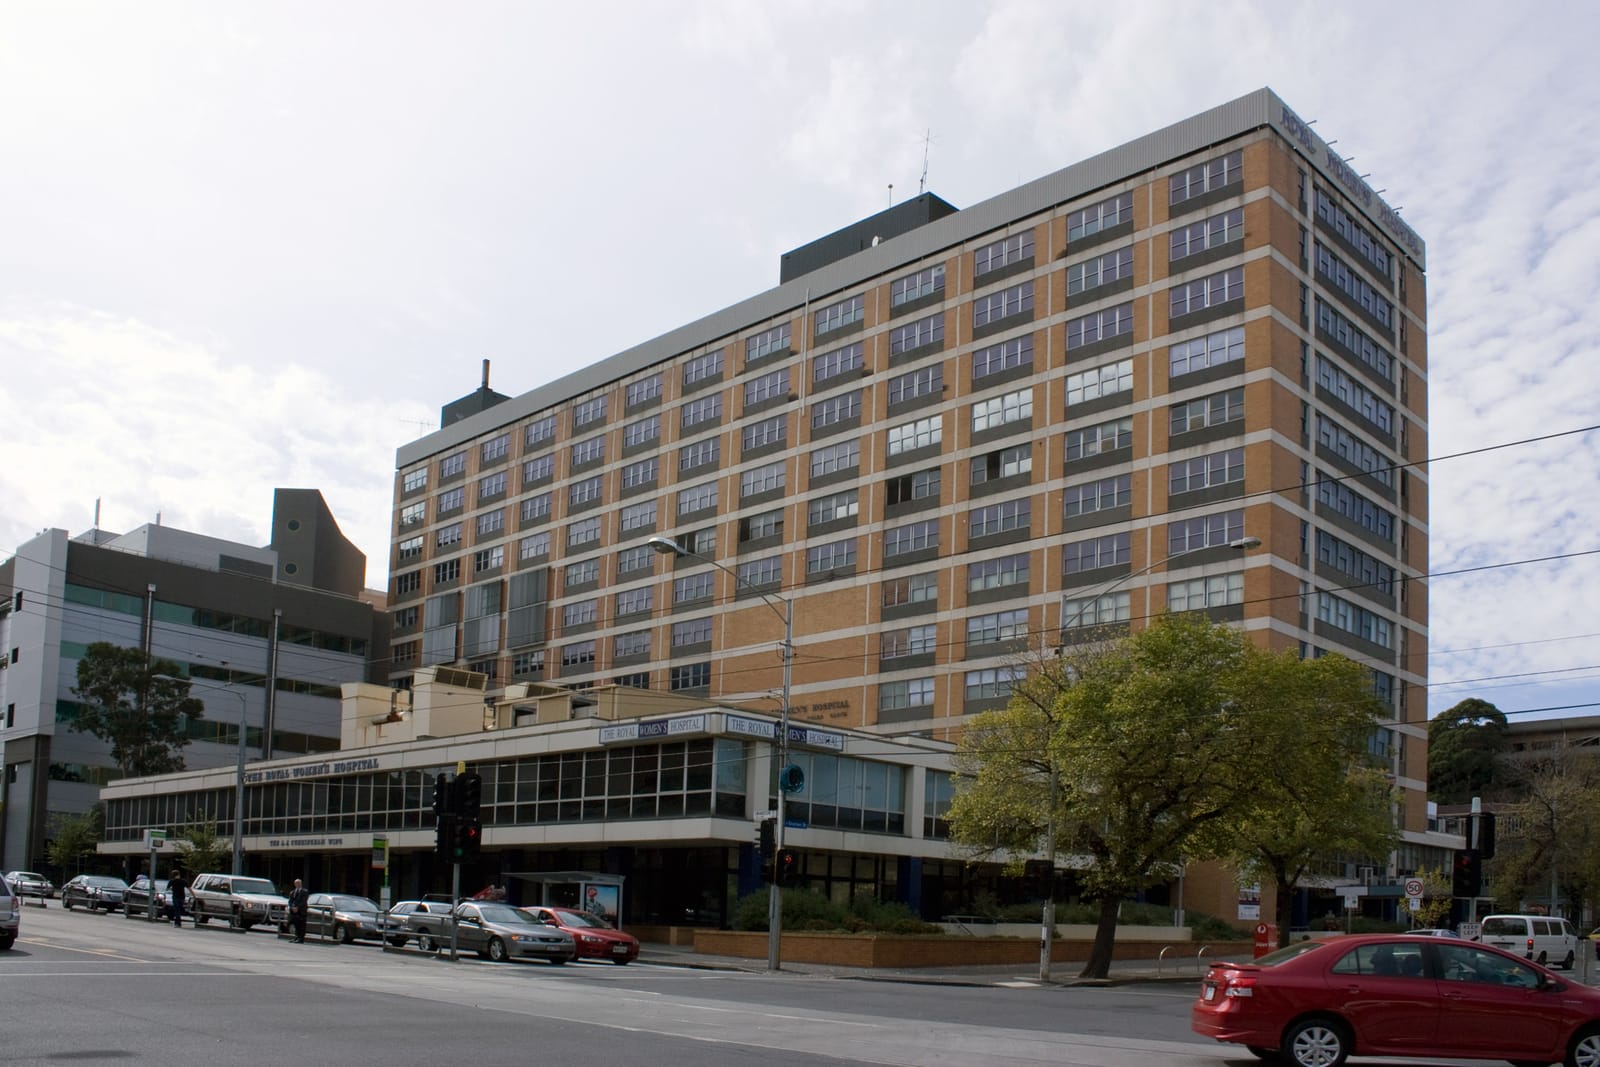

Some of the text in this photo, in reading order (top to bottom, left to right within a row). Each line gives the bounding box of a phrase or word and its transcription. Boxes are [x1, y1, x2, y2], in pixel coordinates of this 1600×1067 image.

[604, 718, 701, 739] THE ROYAL WOMEN'S HOSPITAL
[731, 718, 745, 732] THE
[748, 721, 772, 736] ROYAL
[775, 726, 807, 742] WMEN'S
[266, 768, 290, 780] ROYAL
[293, 763, 330, 777] WOMEN'S
[334, 758, 380, 772] HOSPITAL
[1408, 884, 1419, 893] 50
